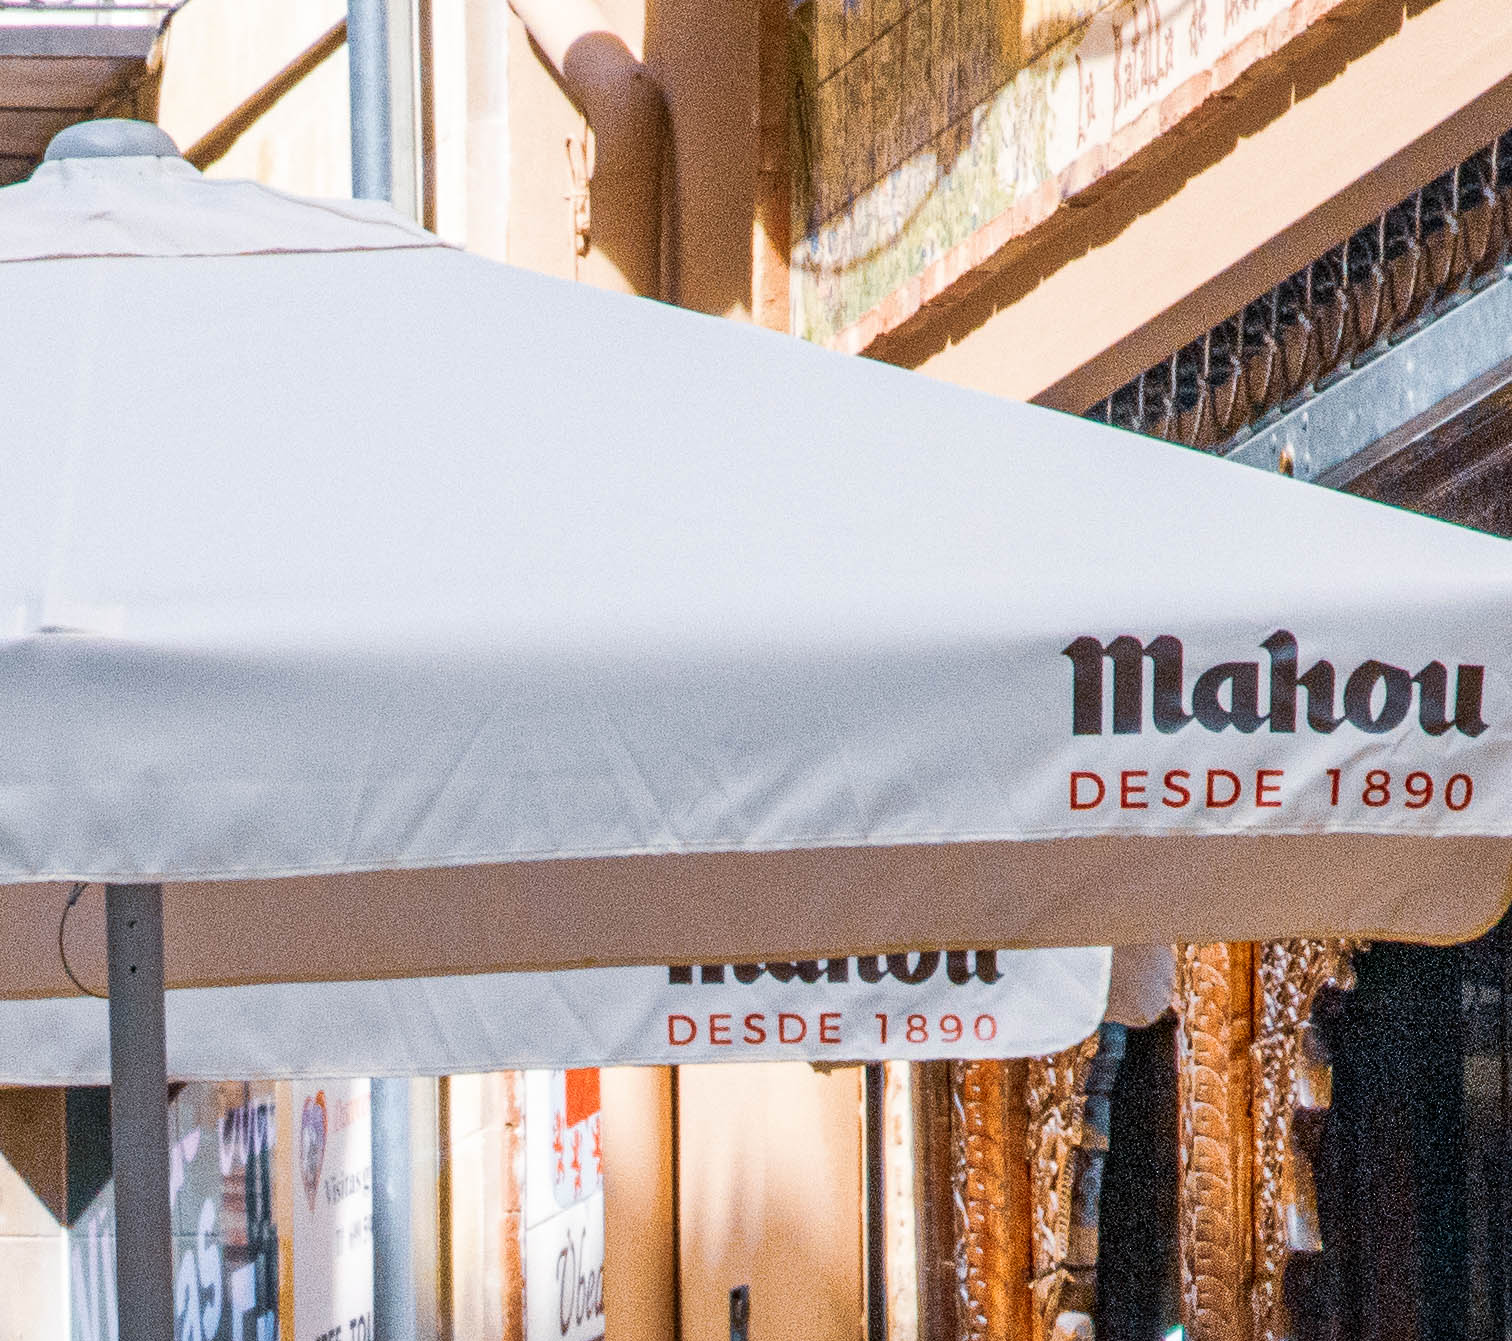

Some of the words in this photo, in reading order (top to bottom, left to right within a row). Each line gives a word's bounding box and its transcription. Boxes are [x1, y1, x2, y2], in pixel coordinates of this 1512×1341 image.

[1061, 629, 1488, 739] Mahou
[1068, 768, 1284, 811] DESDE
[1327, 769, 1474, 812] 1890
[667, 1013, 843, 1046] DESDE
[874, 1012, 999, 1043] 1890
